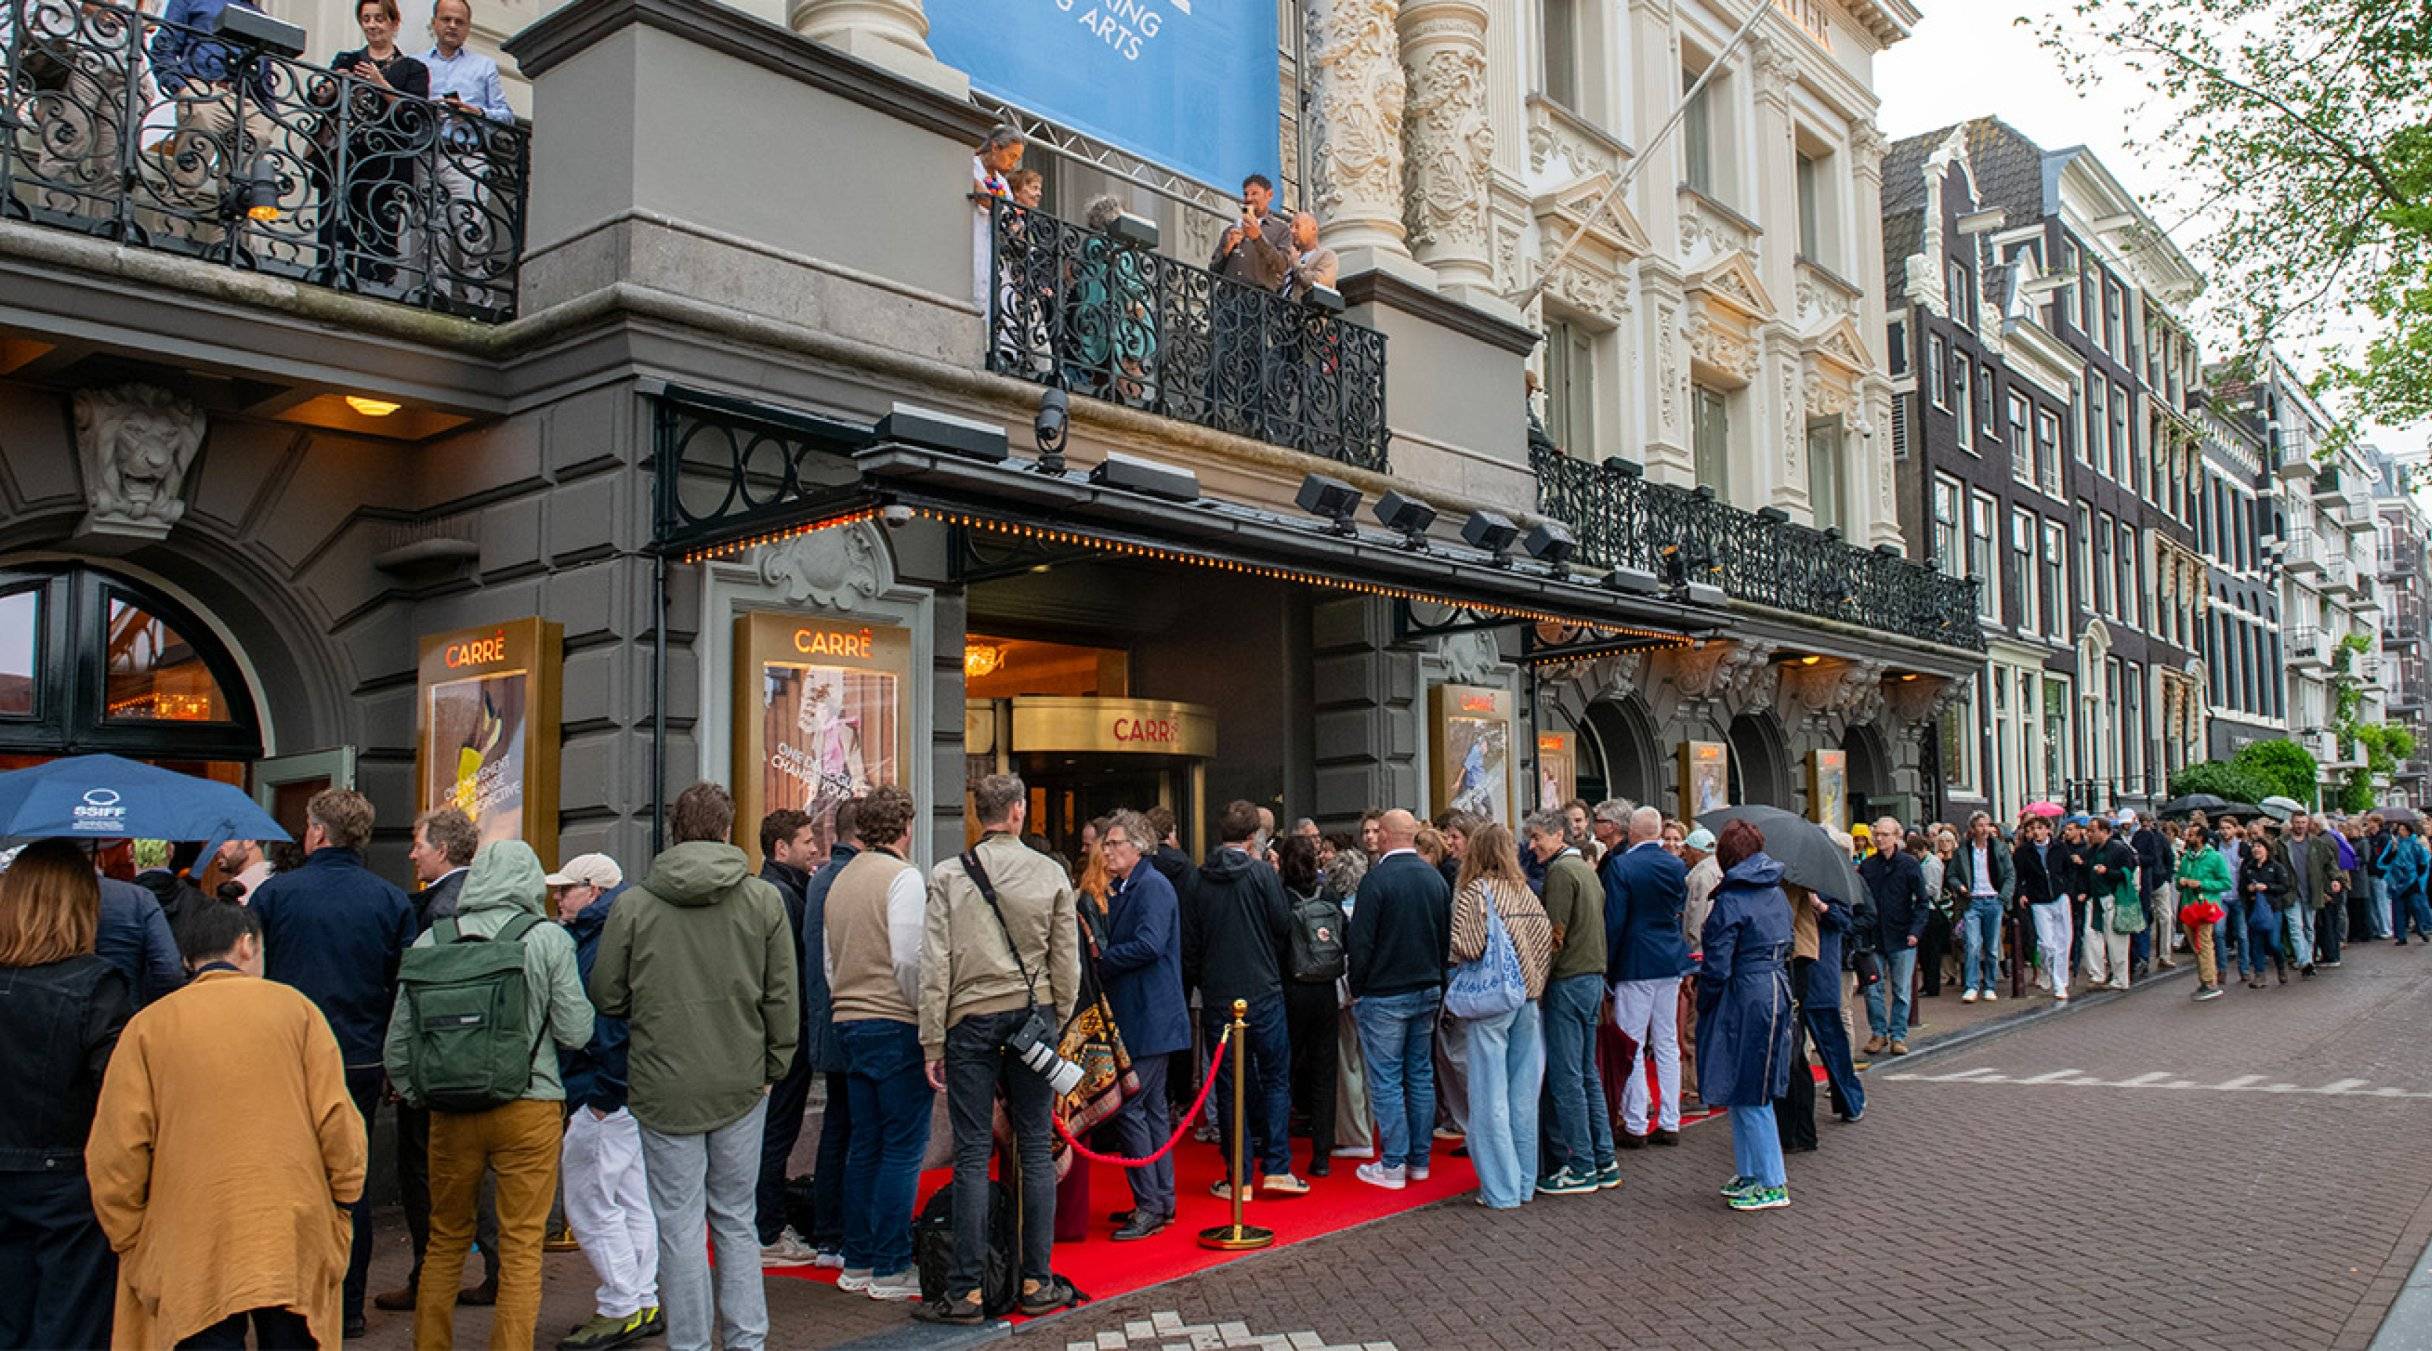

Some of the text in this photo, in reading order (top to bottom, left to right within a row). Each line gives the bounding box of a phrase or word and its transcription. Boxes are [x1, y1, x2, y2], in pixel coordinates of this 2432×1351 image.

[1078, 8, 1143, 60] ARTS
[1105, 0, 1162, 38] ING
[445, 629, 504, 668] CARRÉ
[793, 628, 873, 657] CARRÉ
